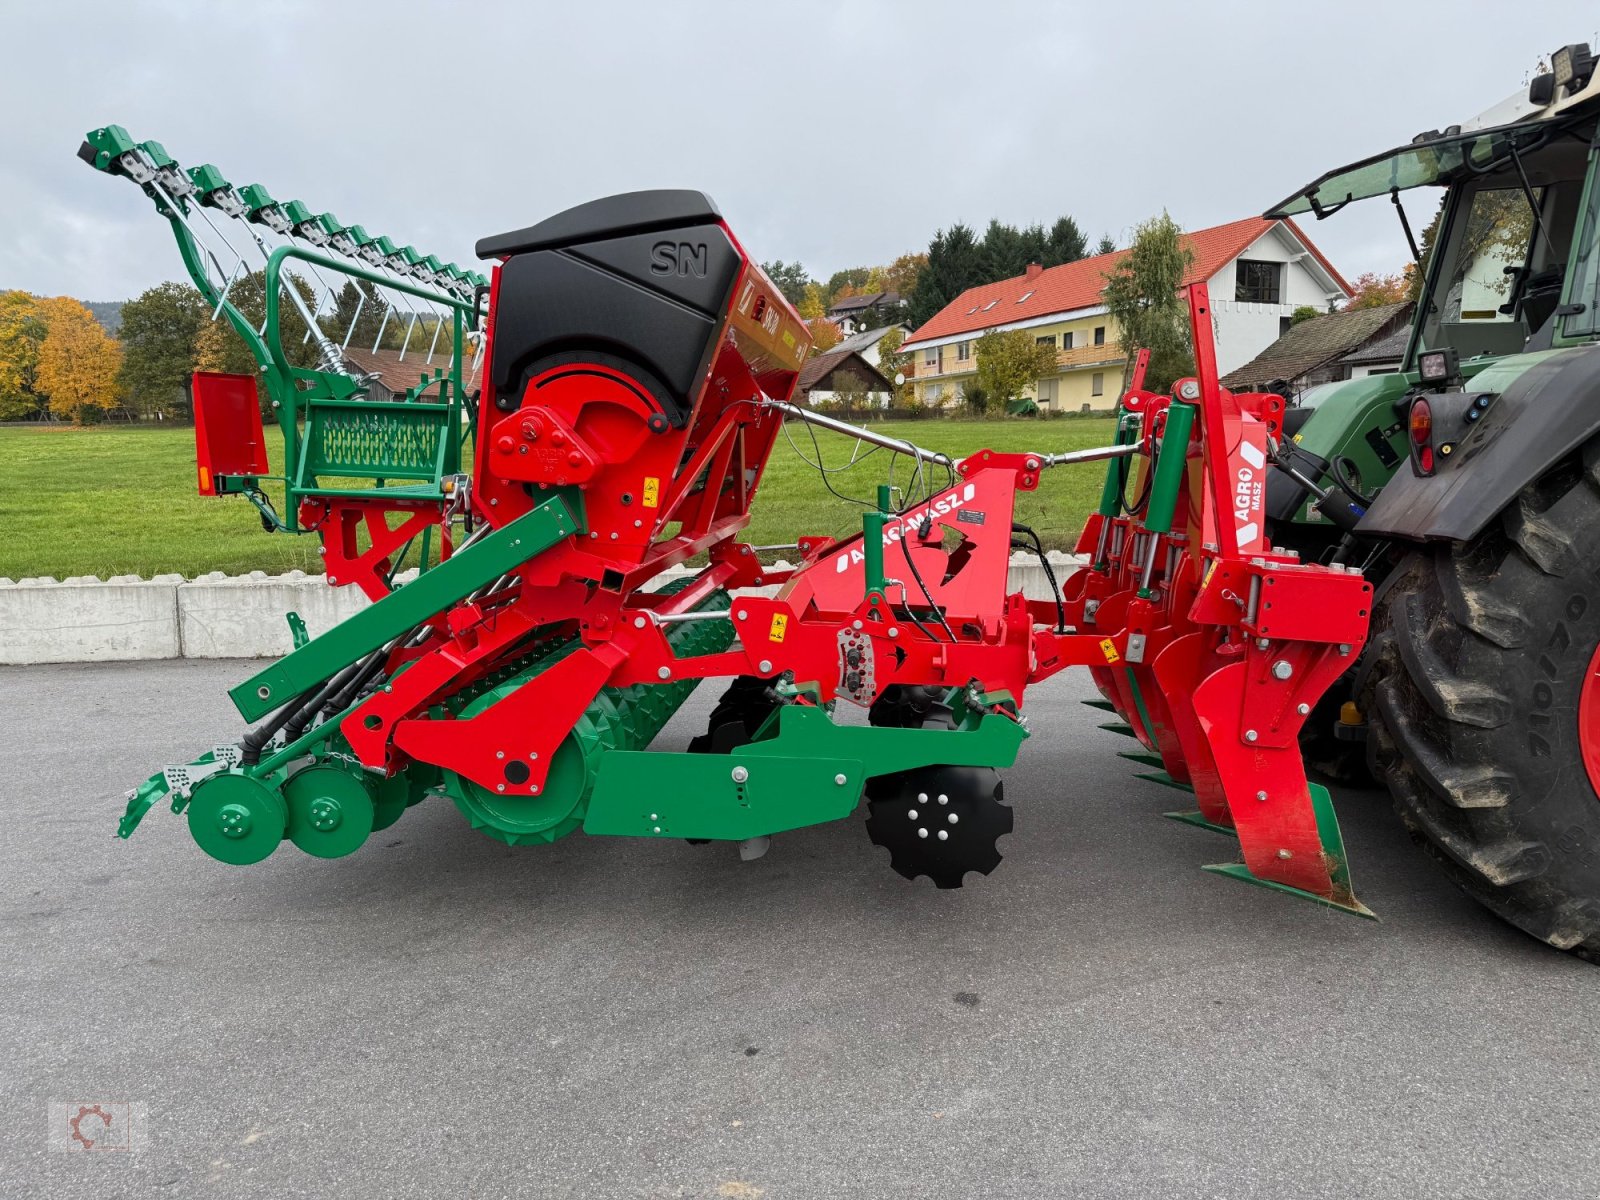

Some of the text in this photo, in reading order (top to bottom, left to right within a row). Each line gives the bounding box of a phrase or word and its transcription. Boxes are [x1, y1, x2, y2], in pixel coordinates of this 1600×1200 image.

[650, 240, 708, 278] SN
[1234, 467, 1253, 521] AGRO
[1251, 482, 1262, 510] MASZ
[850, 493, 964, 565] AO-MASZ
[1527, 593, 1587, 760] 710/70
